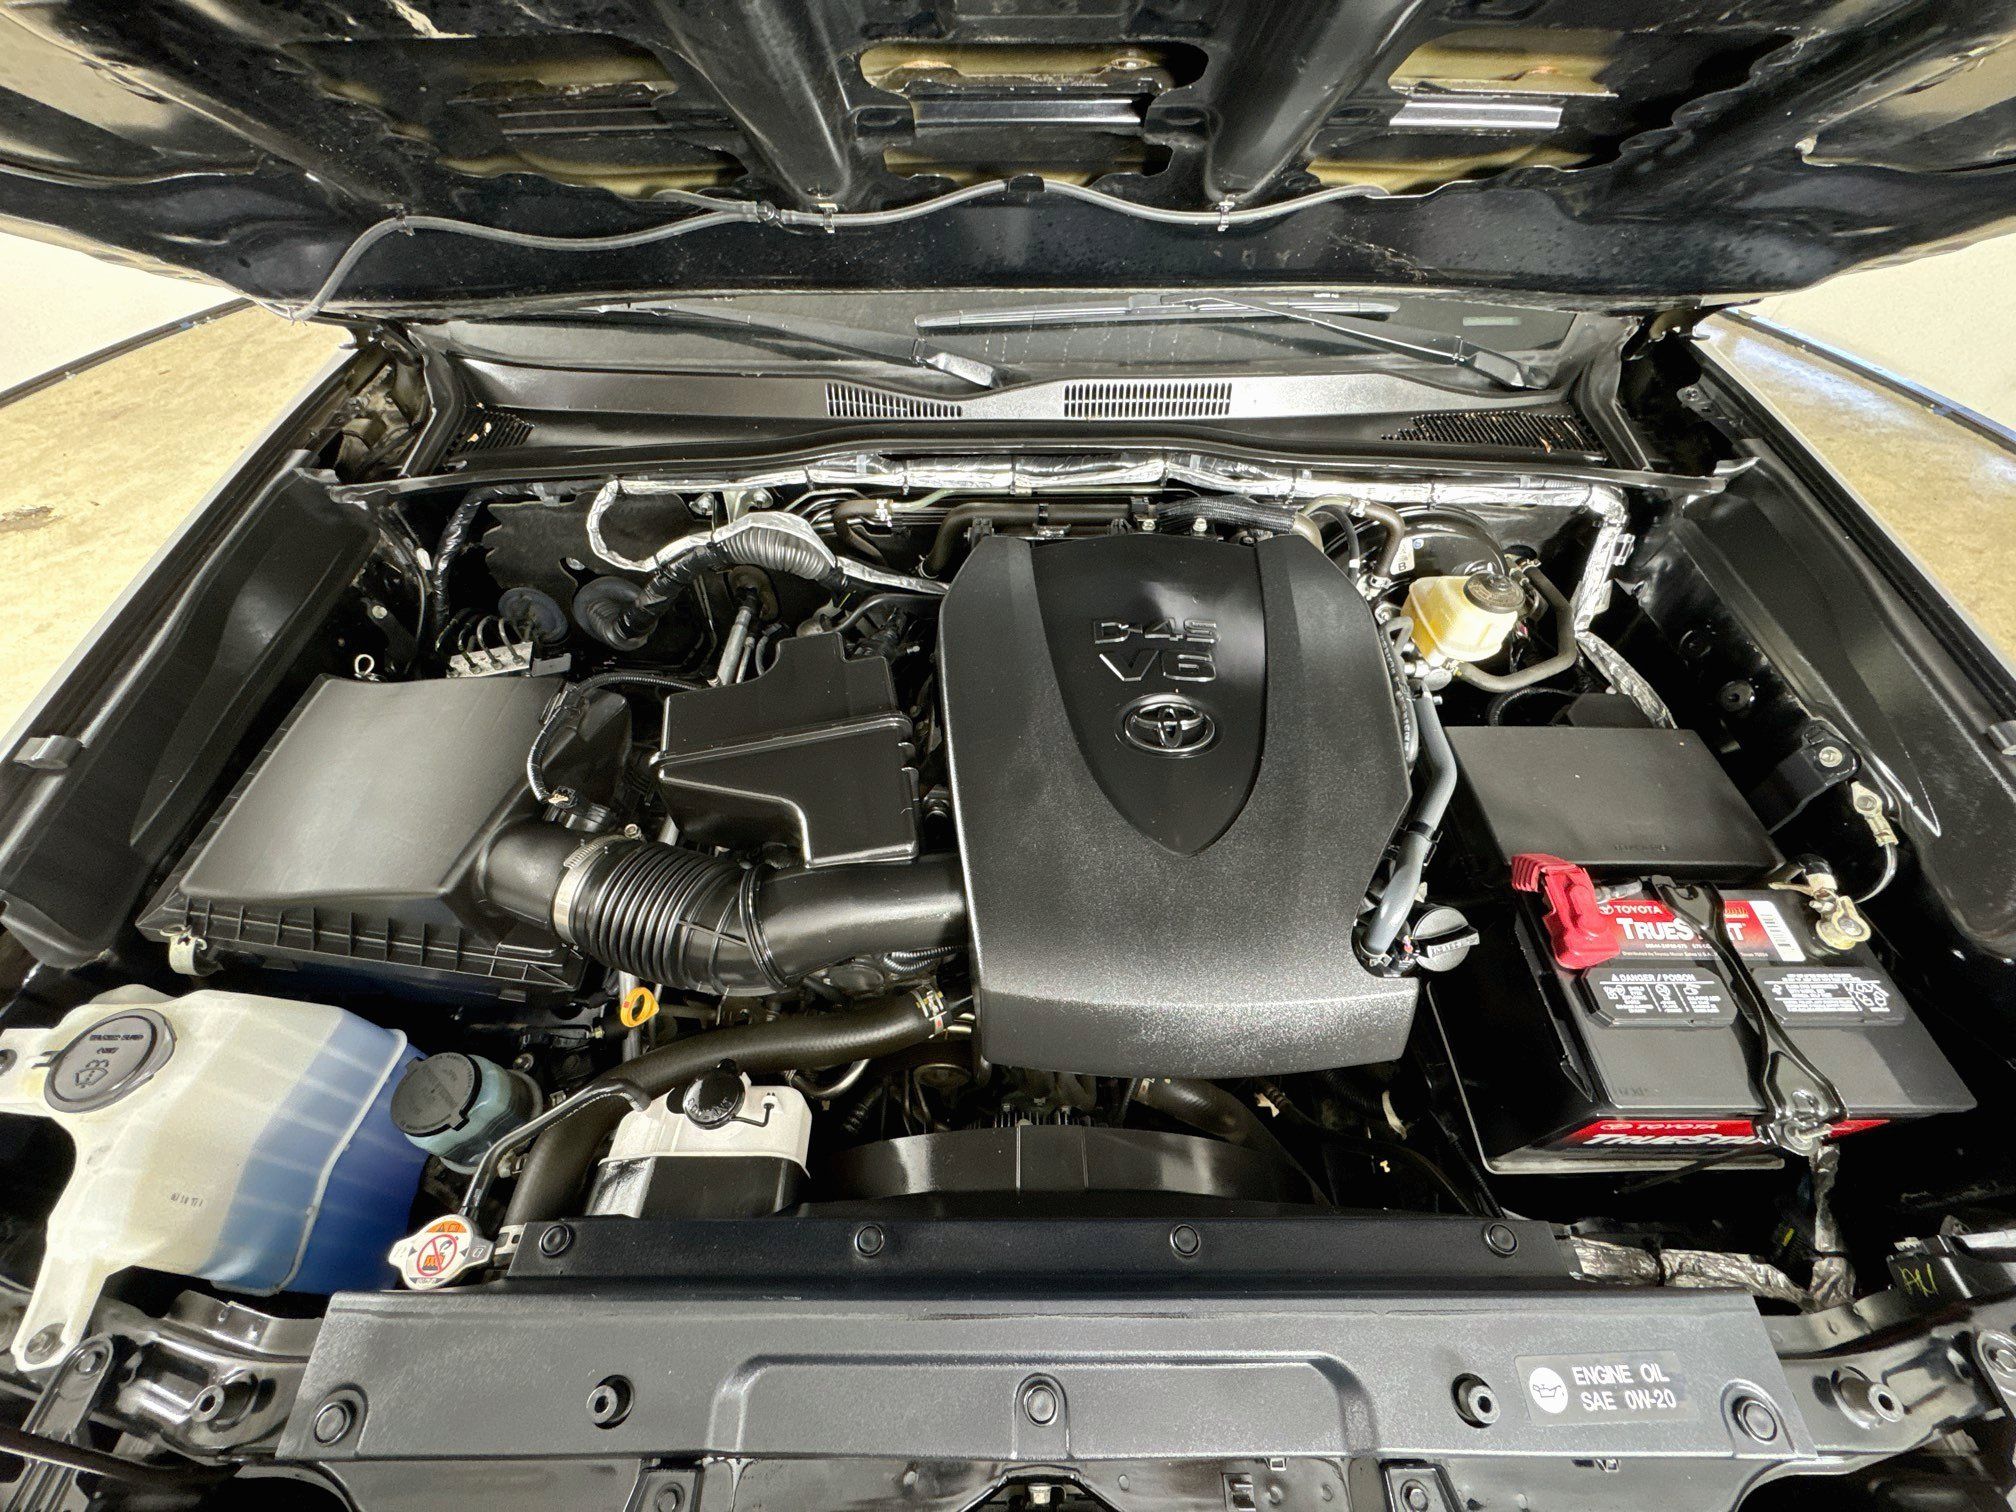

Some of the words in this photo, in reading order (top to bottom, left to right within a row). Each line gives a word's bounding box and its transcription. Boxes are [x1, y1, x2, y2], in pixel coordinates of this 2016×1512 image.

[1093, 617, 1218, 644] D-4S
[1099, 650, 1217, 682] V6
[1614, 905, 1663, 914] TOYOTA
[1619, 973, 1656, 982] DANGER
[1663, 973, 1697, 982] POISON
[1571, 1364, 1634, 1386] ENGINE
[1640, 1363, 1671, 1383] OIL
[1580, 1391, 1618, 1412] SAE
[1624, 1388, 1677, 1410] 0W-20
